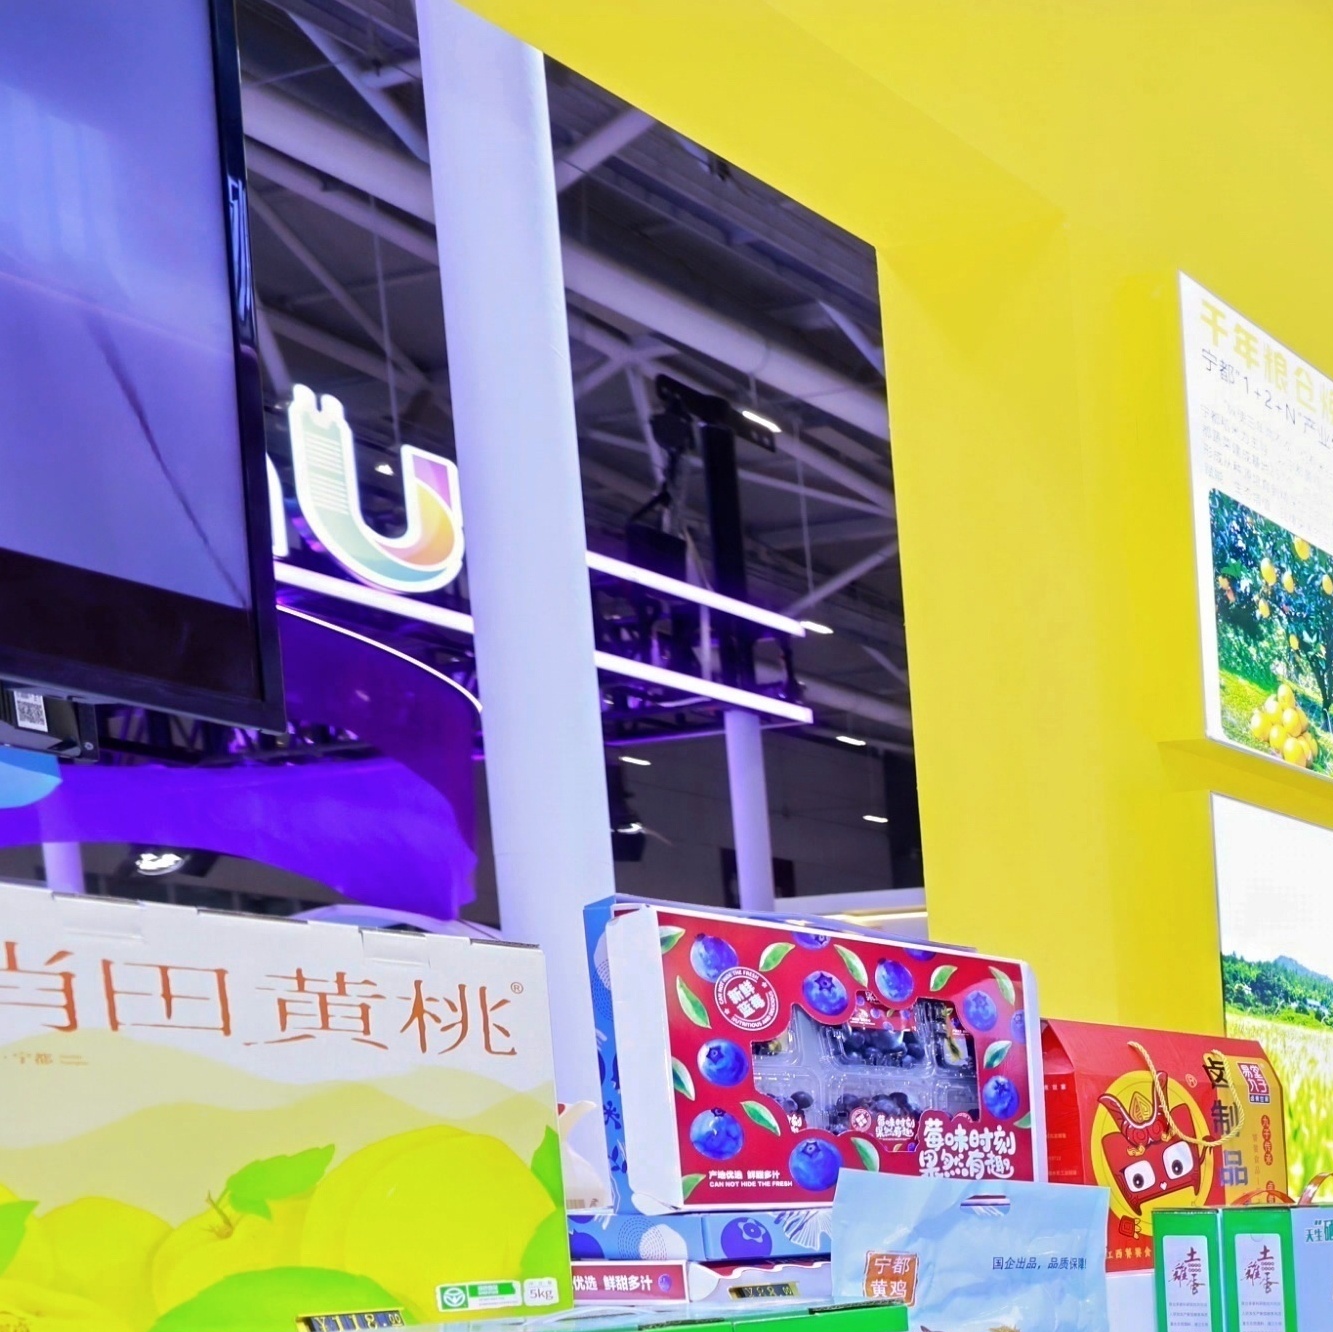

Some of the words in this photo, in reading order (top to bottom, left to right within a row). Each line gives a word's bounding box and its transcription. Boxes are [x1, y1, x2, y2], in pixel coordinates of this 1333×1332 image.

[727, 979, 755, 1004] 新鲜
[1203, 1057, 1248, 1186] 卤制品
[924, 1118, 1016, 1155] 莓味时刻
[919, 1149, 1014, 1179] 果然有趣
[874, 1257, 911, 1274] 宁都
[571, 1275, 598, 1291] 优选
[603, 1275, 652, 1291] 鲜甜多汁
[870, 1280, 907, 1298] 黄鸡
[529, 1287, 553, 1302] 5kg
